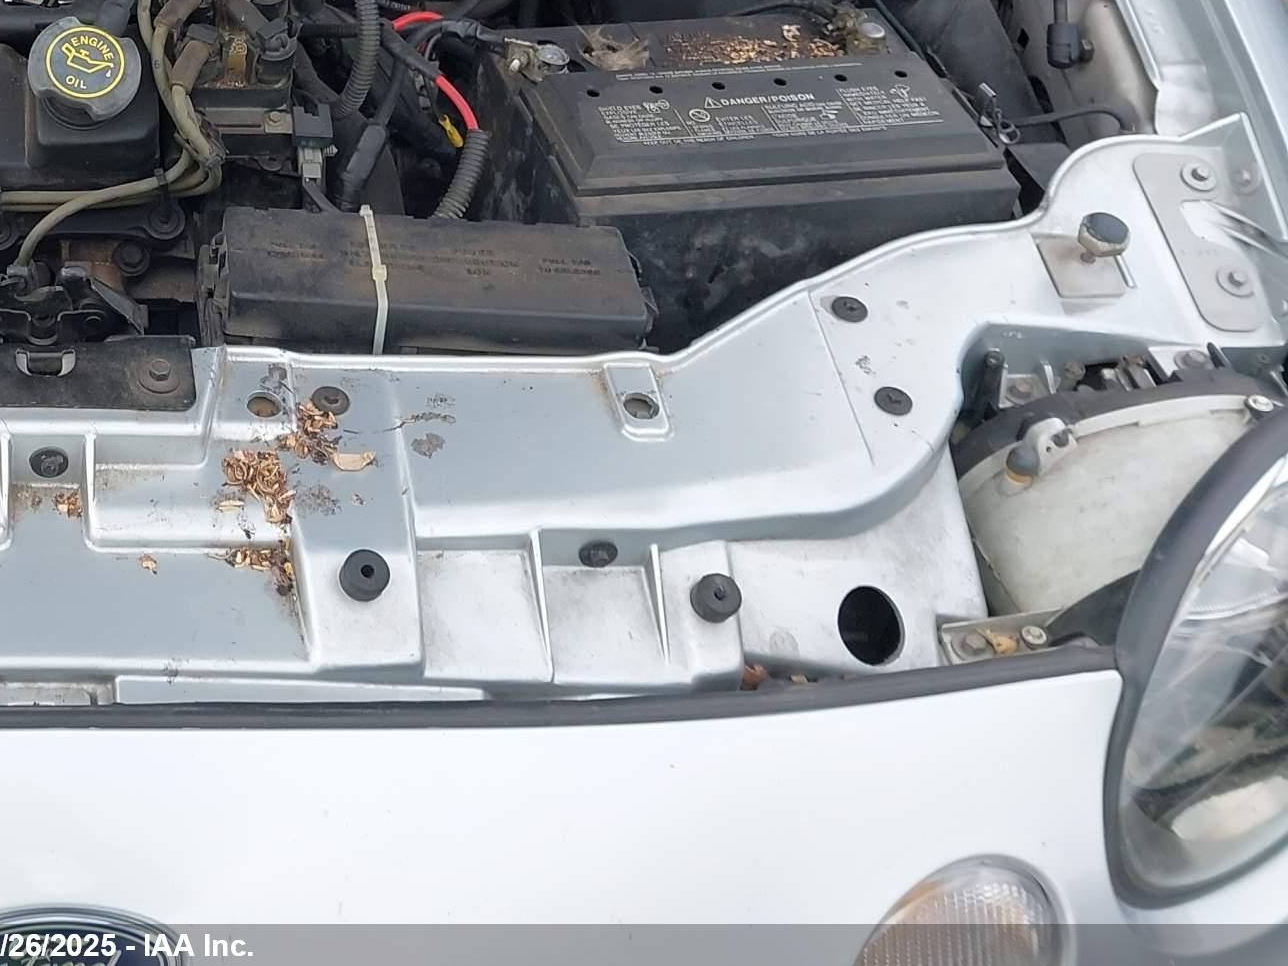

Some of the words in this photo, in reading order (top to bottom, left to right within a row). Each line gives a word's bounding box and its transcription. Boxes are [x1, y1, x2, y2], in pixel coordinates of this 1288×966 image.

[70, 35, 115, 61] ENGINE
[65, 75, 87, 89] OIL
[720, 93, 815, 106] DANGER/POISON
